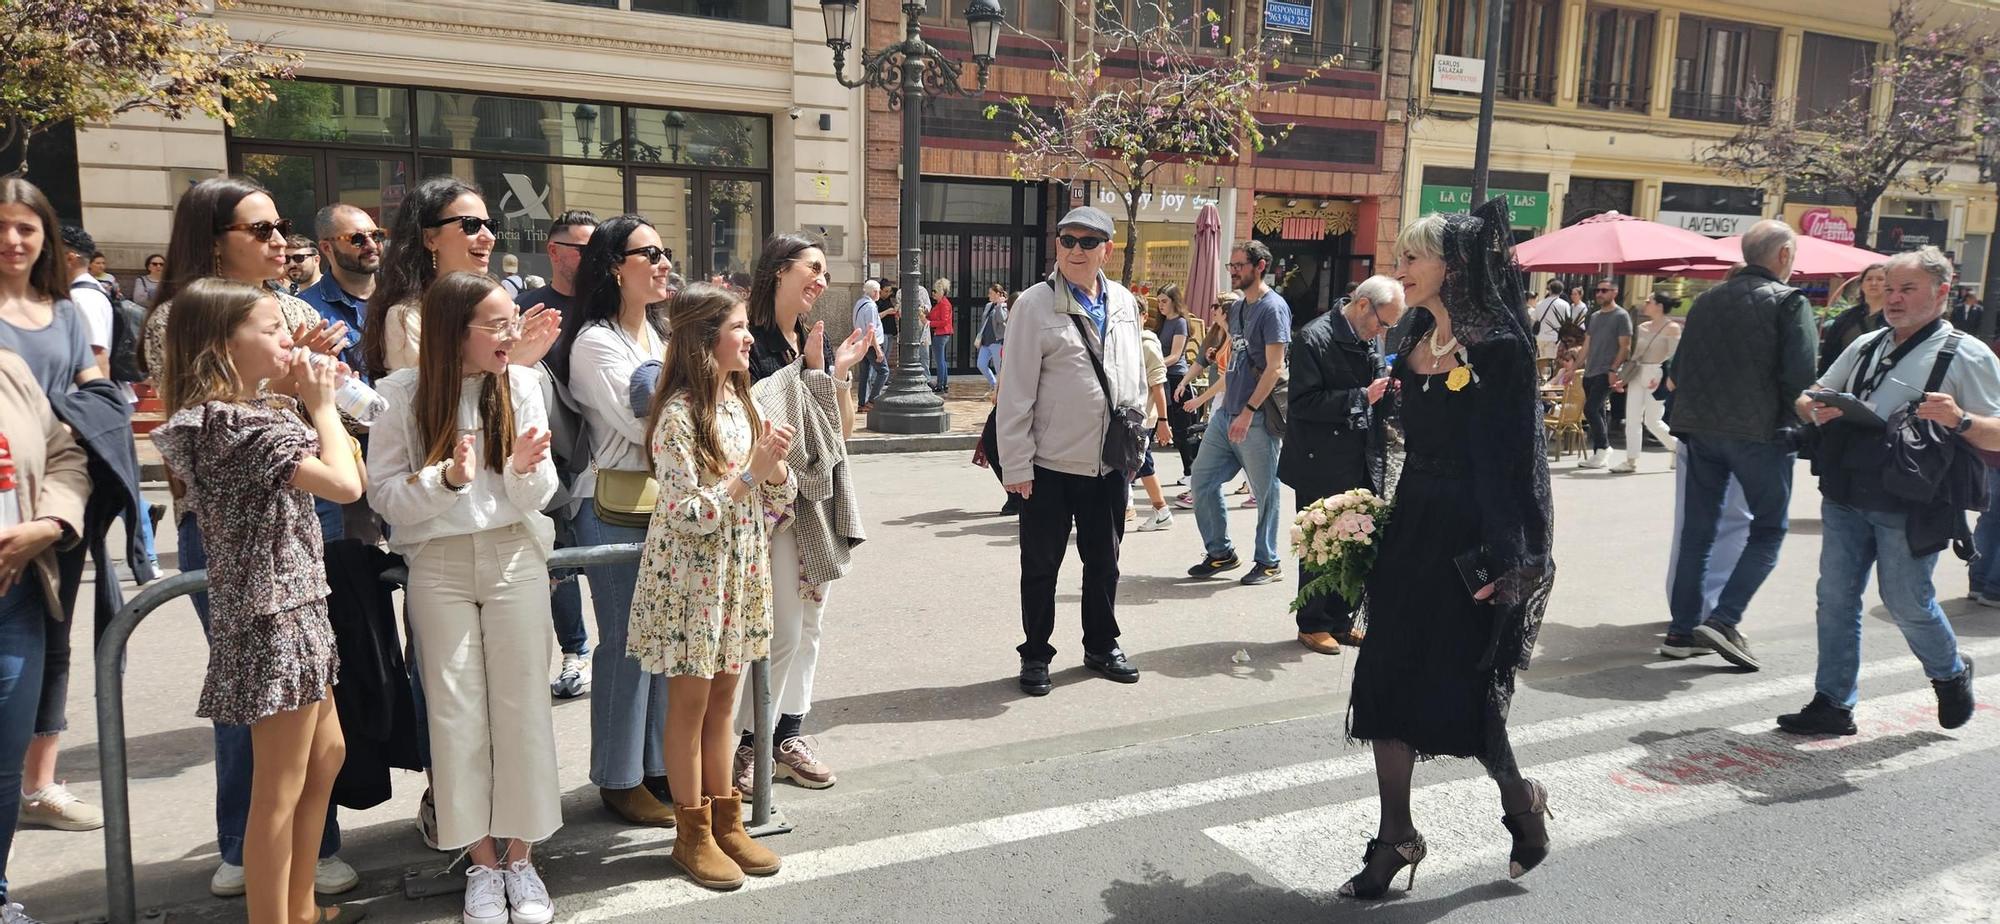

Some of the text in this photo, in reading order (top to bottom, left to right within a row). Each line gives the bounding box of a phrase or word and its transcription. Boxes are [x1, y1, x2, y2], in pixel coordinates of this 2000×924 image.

[1269, 4, 1309, 16] DISPONIBLE
[1268, 12, 1309, 26] 963 942 282
[1438, 66, 1464, 74] SALAZAR
[1074, 188, 1083, 198] 10
[1100, 187, 1116, 204] io
[1160, 190, 1185, 212] joy
[1439, 190, 1456, 203] LA
[1513, 195, 1537, 207] LAS
[1680, 215, 1739, 233] LAVENGY
[1807, 211, 1829, 237] Tu
[494, 229, 520, 240] ncia
